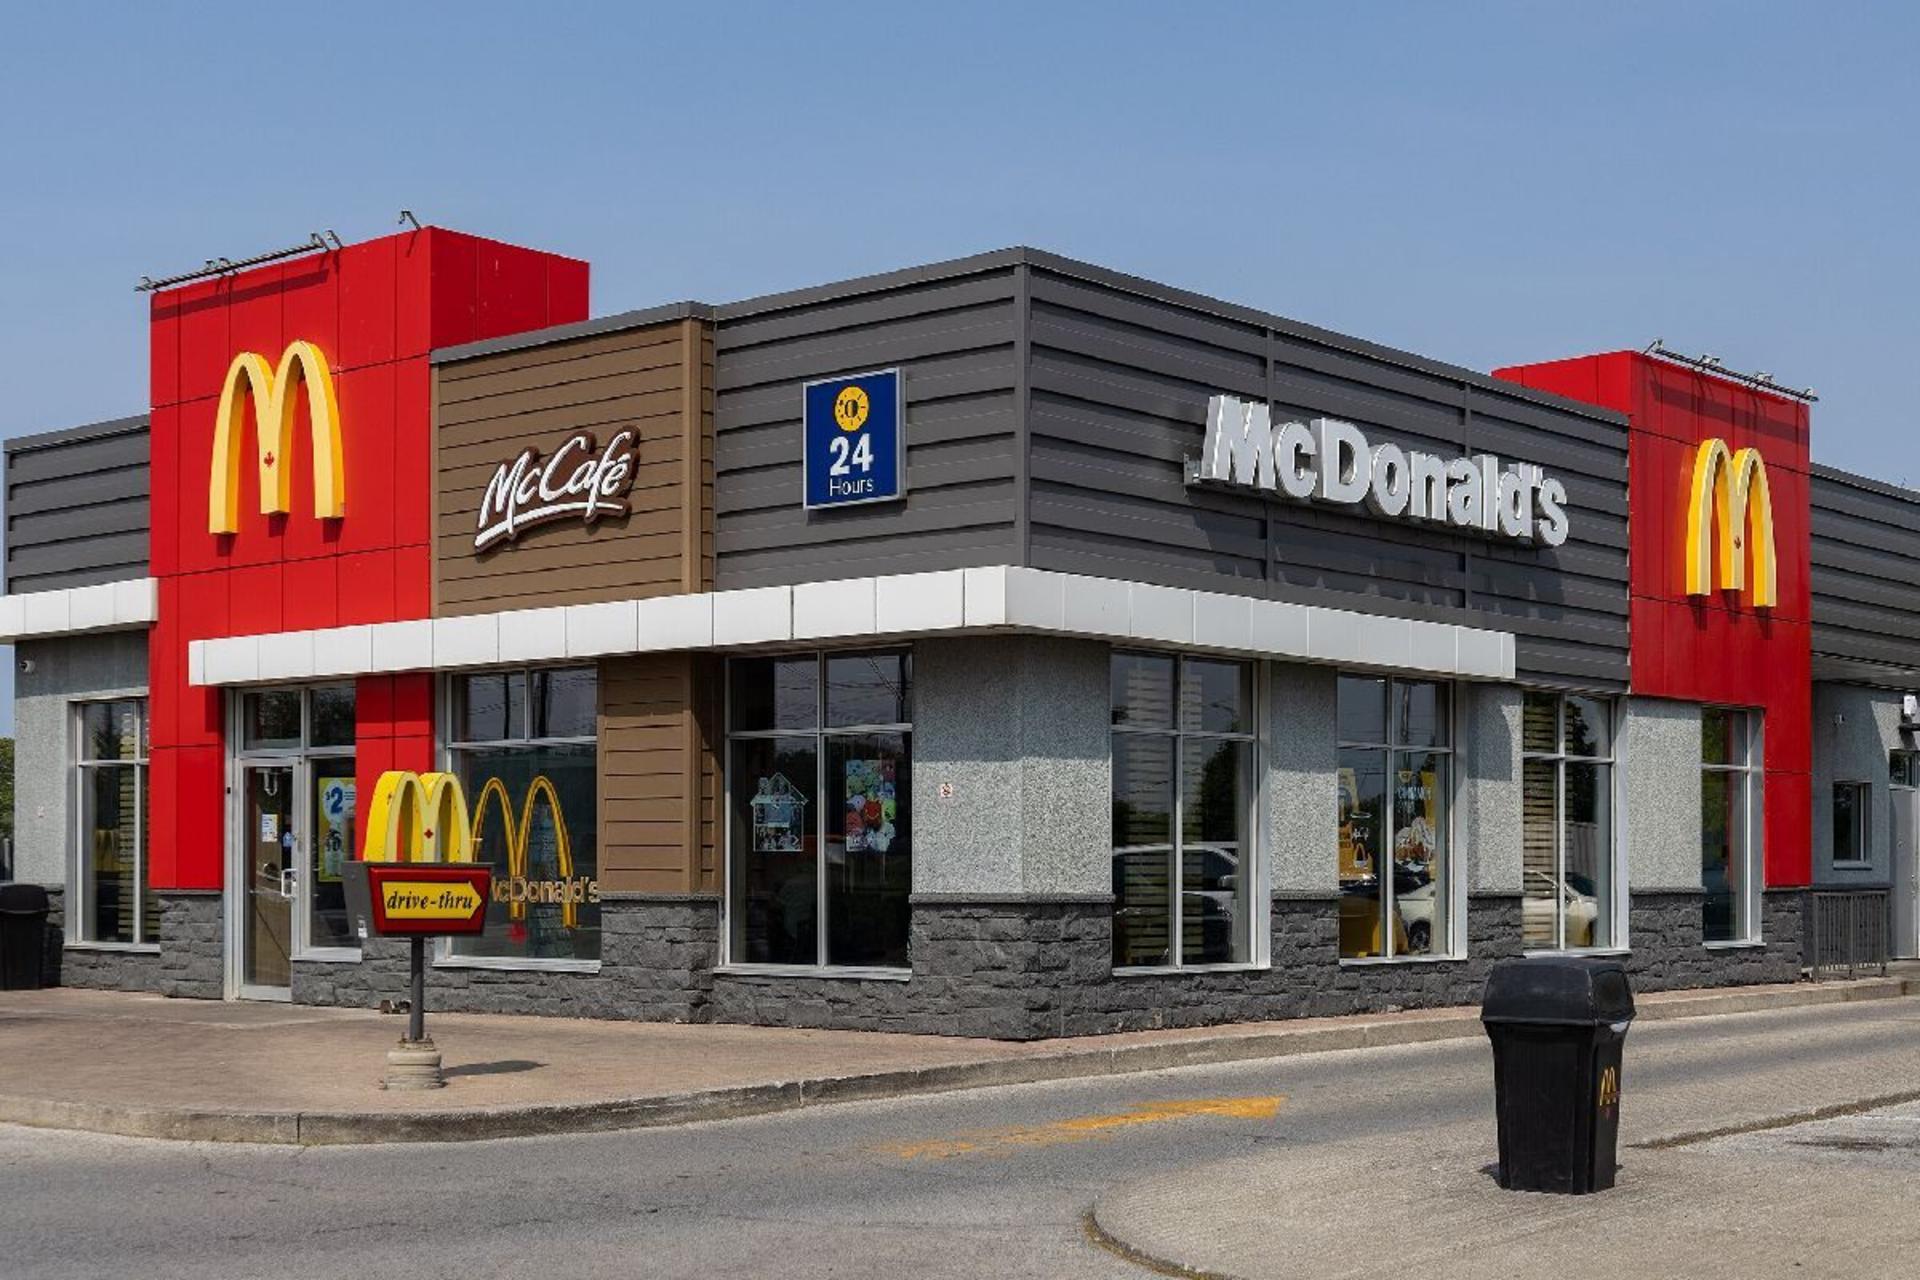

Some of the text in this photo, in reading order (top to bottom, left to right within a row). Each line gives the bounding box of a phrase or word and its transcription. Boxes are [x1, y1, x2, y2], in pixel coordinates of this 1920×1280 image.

[830, 433, 874, 477] 24
[1199, 394, 1570, 547] McDonald's
[476, 429, 632, 538] McCafé
[829, 477, 874, 497] Hours
[386, 890, 473, 910] drive-thru
